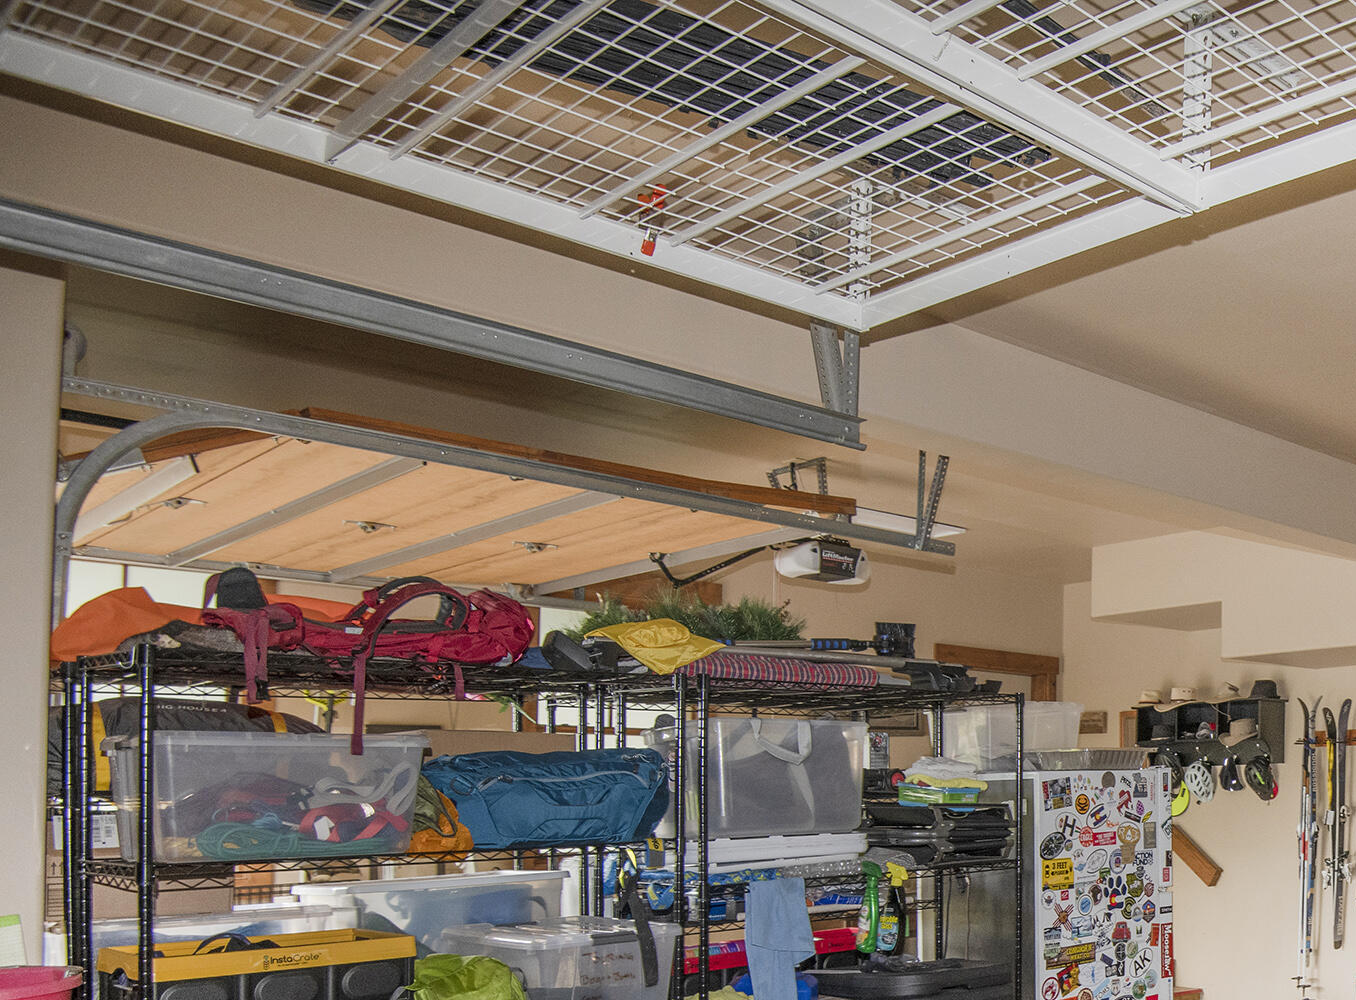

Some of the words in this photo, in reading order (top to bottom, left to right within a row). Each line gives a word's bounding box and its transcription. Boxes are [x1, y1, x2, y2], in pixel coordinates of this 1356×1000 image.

[1135, 852, 1153, 860] CTION
[1056, 861, 1068, 869] FEET
[270, 953, 320, 965] InstaCrate
[1133, 949, 1151, 976] AK
